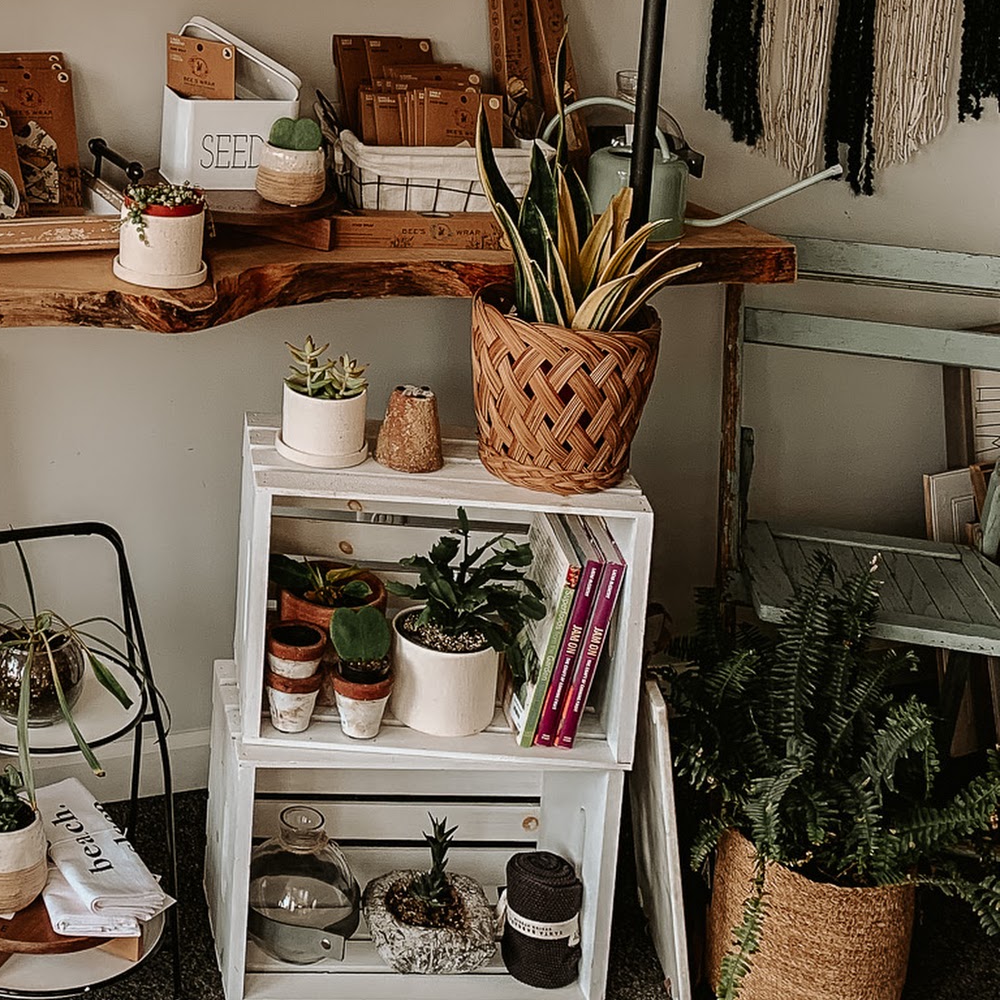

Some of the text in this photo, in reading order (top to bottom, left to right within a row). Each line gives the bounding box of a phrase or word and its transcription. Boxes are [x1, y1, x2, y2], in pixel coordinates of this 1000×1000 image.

[200, 134, 265, 170] SEED
[555, 589, 571, 631] Superfoods
[570, 624, 583, 642] JAM
[591, 626, 604, 644] JAM
[566, 641, 578, 655] ON
[586, 643, 600, 657] ON
[542, 655, 554, 681] Garden
